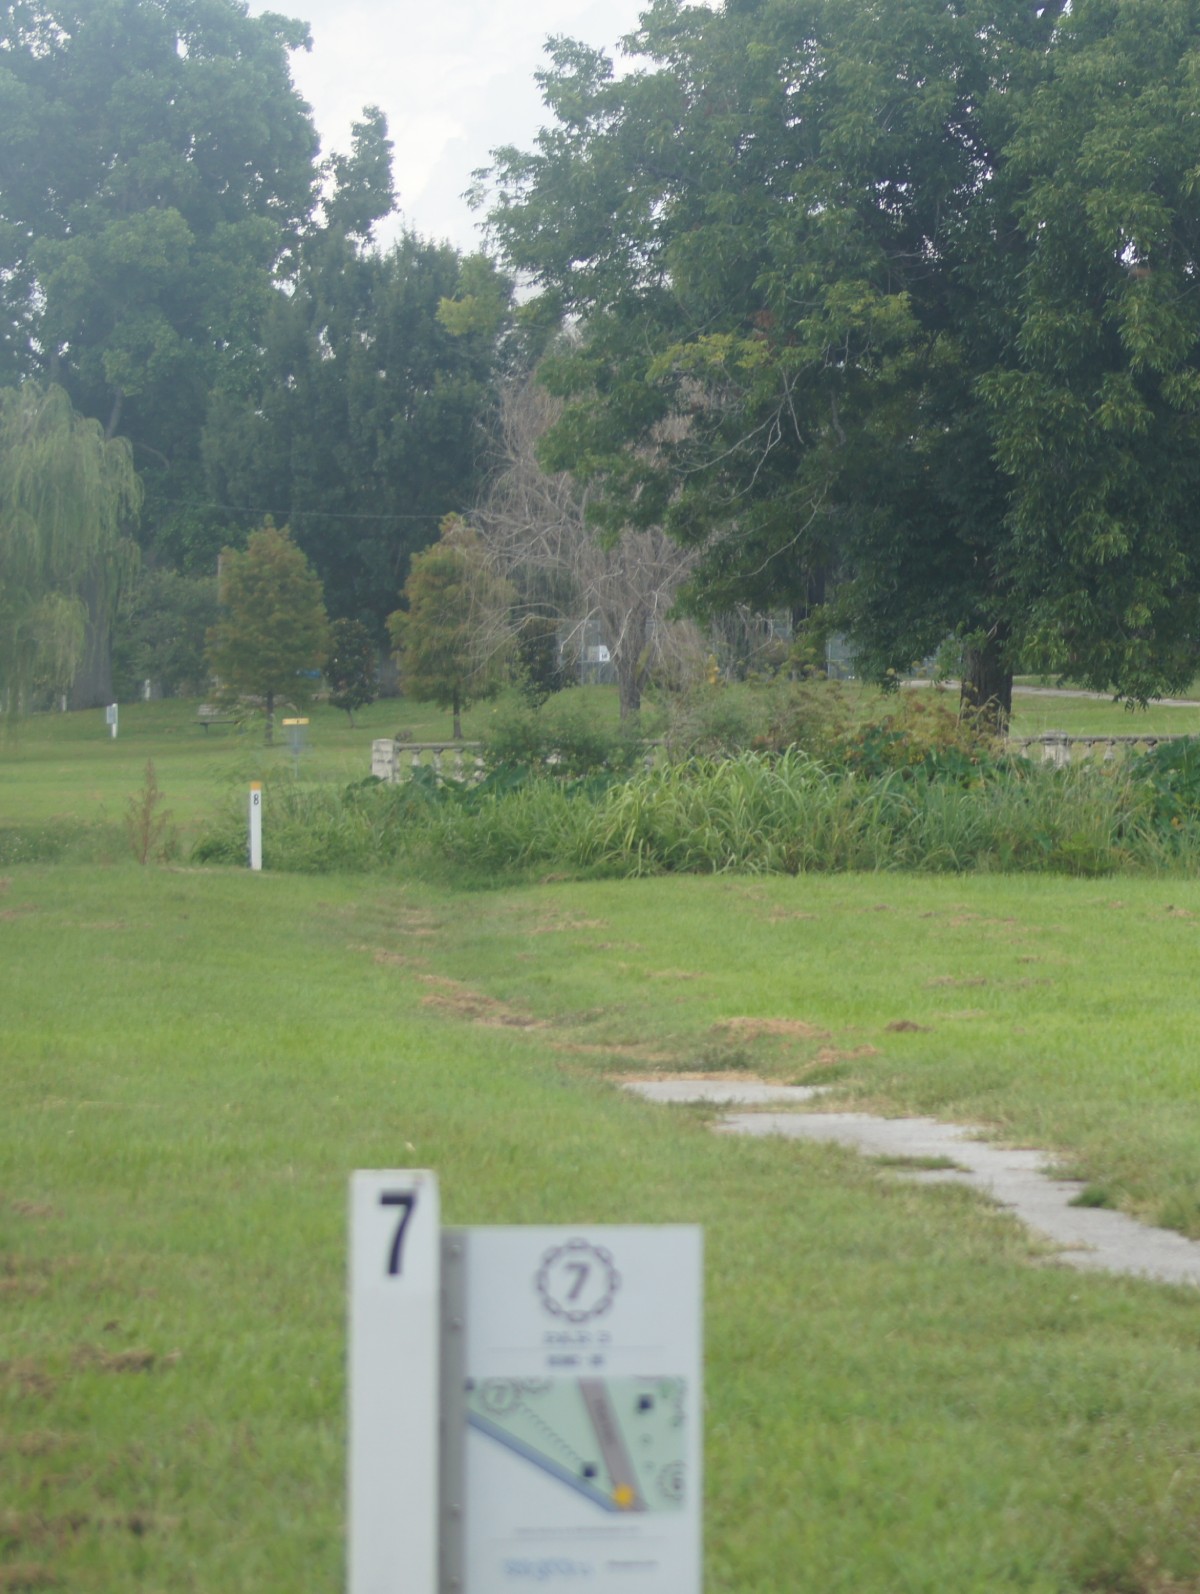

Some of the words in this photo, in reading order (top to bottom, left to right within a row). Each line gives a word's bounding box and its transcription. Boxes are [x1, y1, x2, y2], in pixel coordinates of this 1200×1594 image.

[253, 793, 260, 806] 8
[380, 1190, 416, 1275] 7
[564, 1261, 590, 1301] 7
